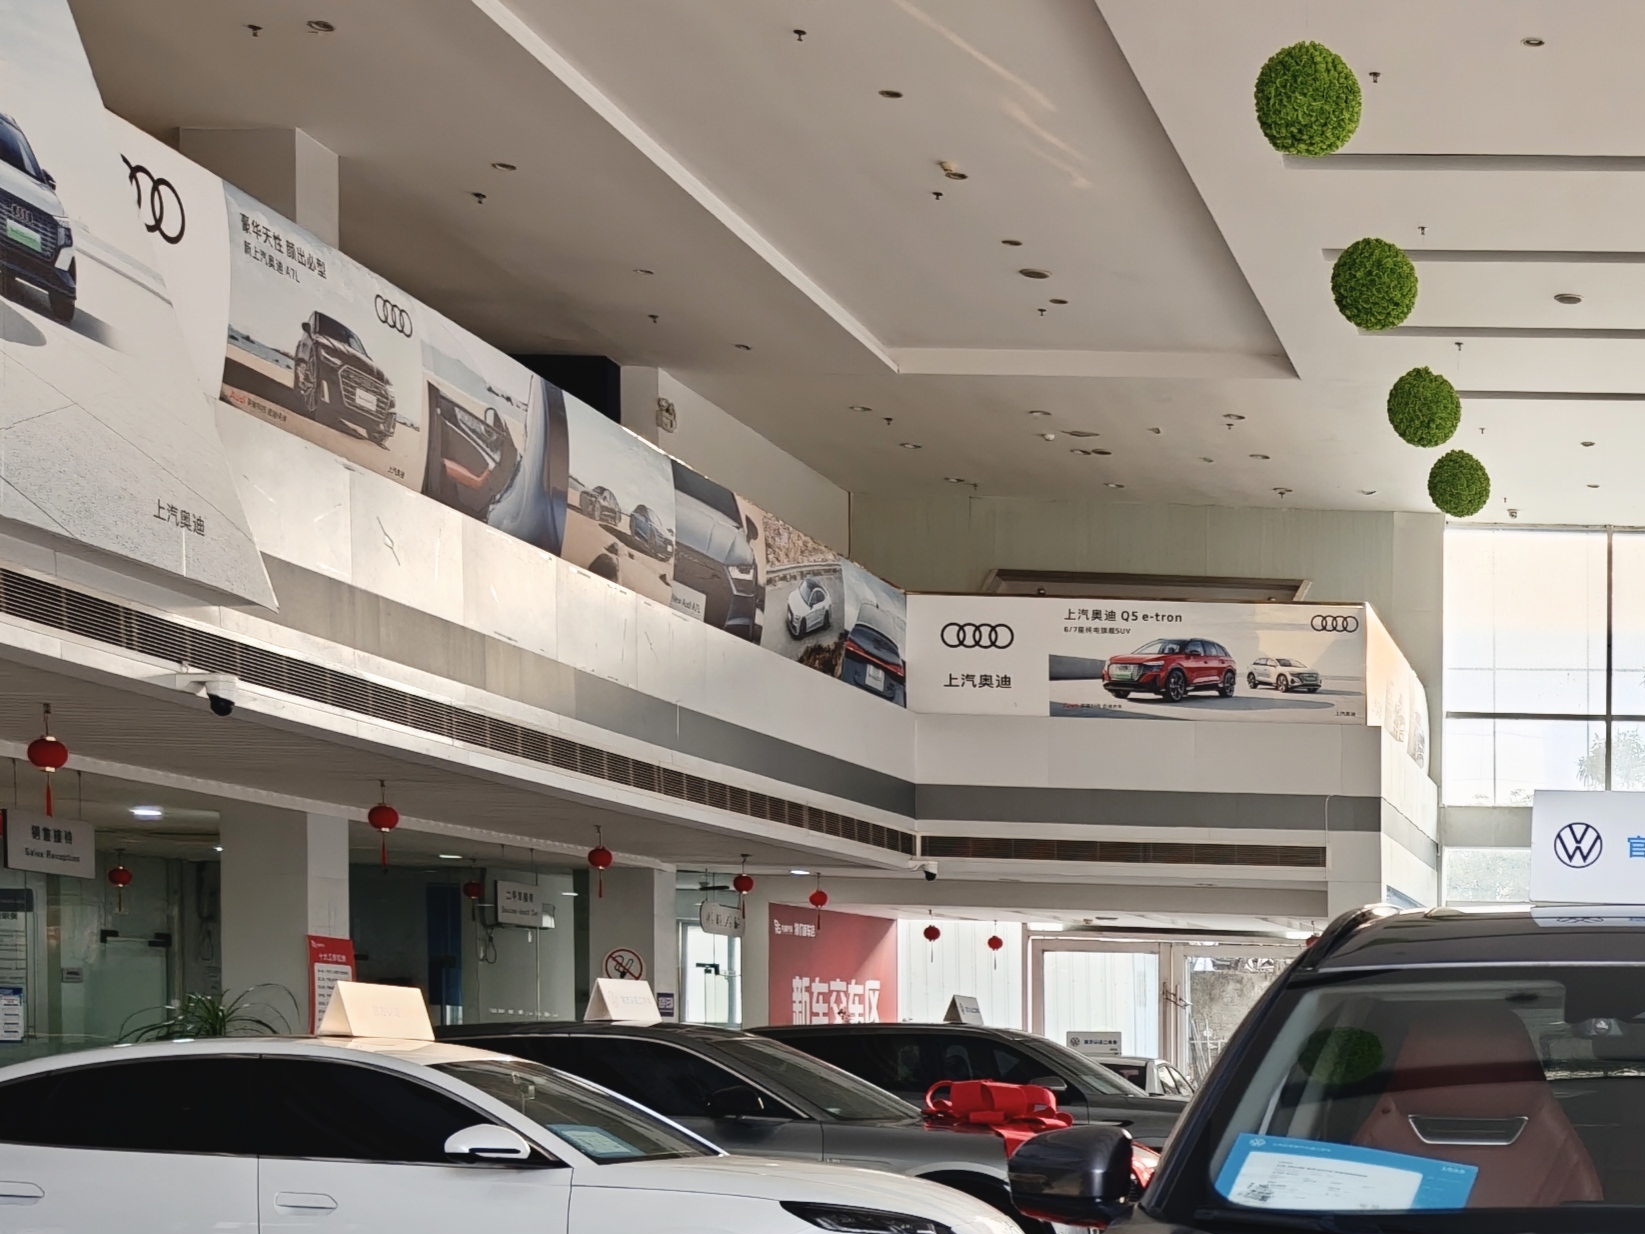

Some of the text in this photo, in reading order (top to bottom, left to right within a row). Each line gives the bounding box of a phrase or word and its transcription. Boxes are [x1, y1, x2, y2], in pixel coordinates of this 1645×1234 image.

[239, 212, 284, 254] 豪华天性
[153, 498, 206, 537] 上汽奥迪
[1063, 608, 1183, 623] 上汽奥迪 Q5 e-tron
[943, 673, 1013, 689] 上汽奥迪
[792, 975, 881, 1024] 新车交车区
